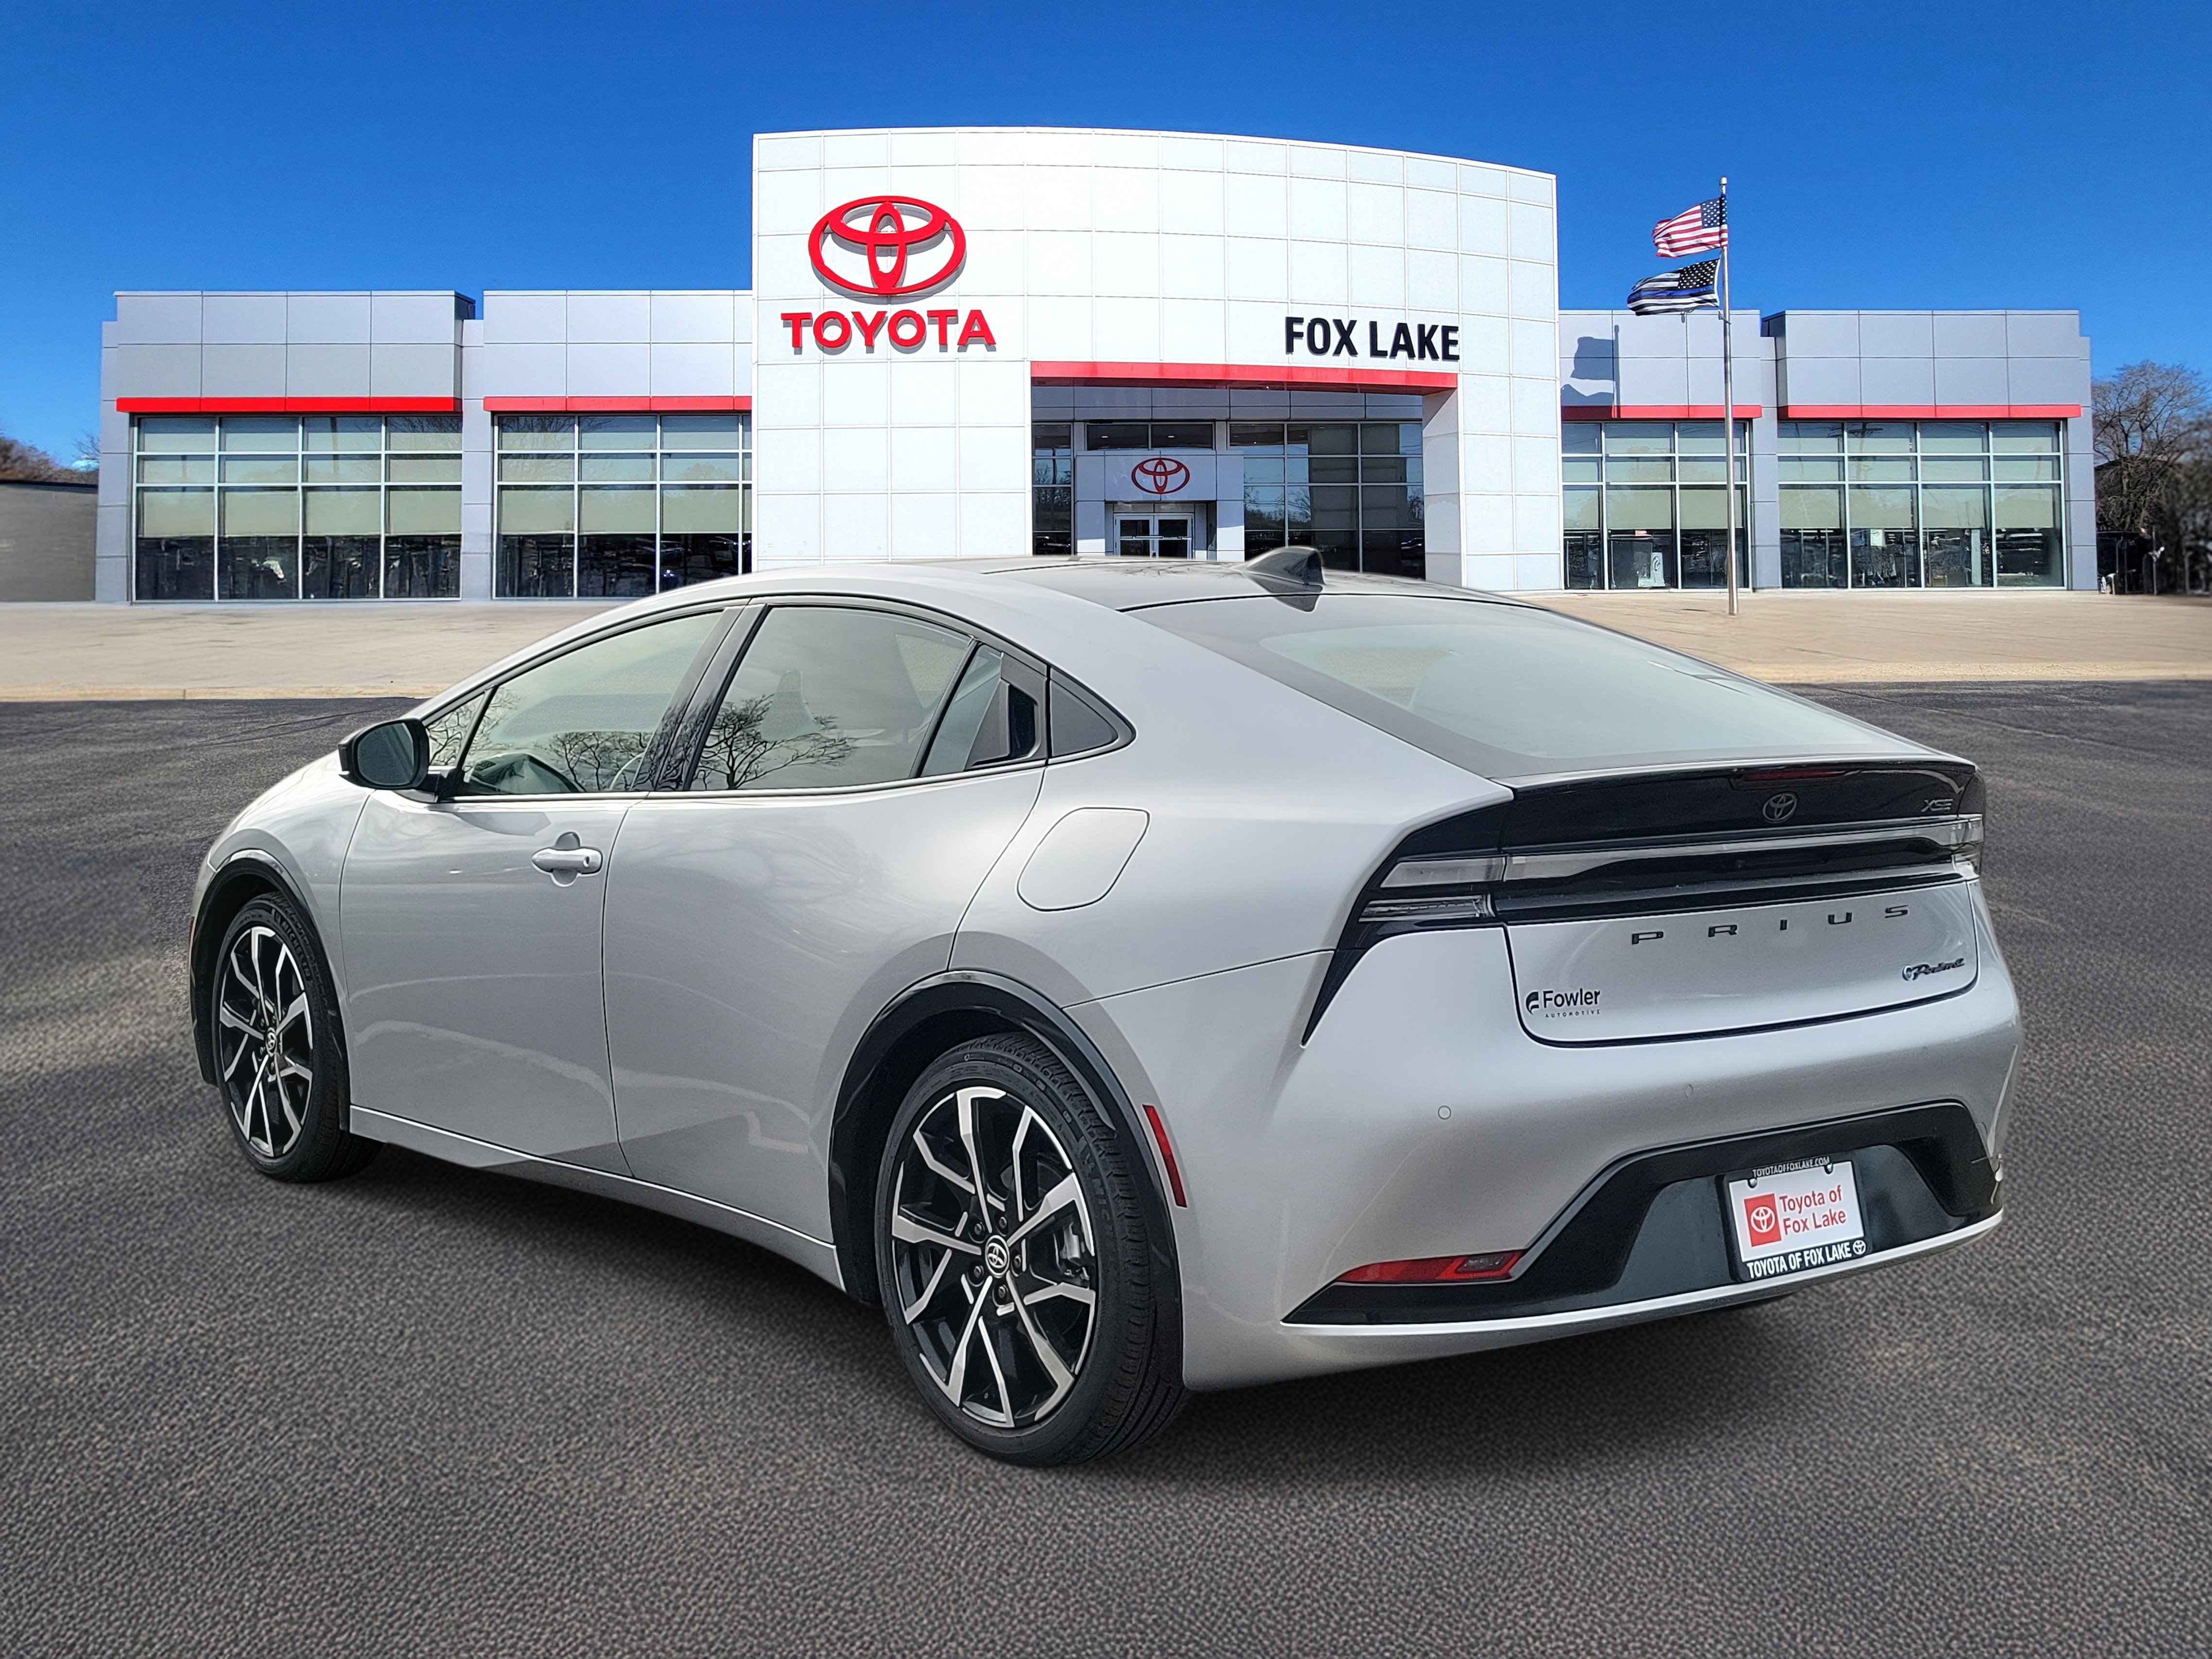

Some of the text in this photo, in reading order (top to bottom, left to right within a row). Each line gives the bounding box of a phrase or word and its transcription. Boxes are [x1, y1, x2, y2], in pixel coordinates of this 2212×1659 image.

[781, 310, 997, 349] TOYOTA
[1285, 316, 1460, 360] FOX LAKE
[1921, 798, 1953, 812] XSE
[1631, 905, 1908, 945] PRIUS
[1543, 988, 1600, 1008] Fowler
[1545, 1009, 1600, 1018] AUTOMOTIVE
[1752, 1156, 1831, 1177] TOYOTAOFFOXLAKE.COM
[1779, 1185, 1842, 1214] Toyota of
[1783, 1209, 1847, 1235] Fox Lake
[1747, 1242, 1852, 1279] TOYOTA OF FOX LAKE
